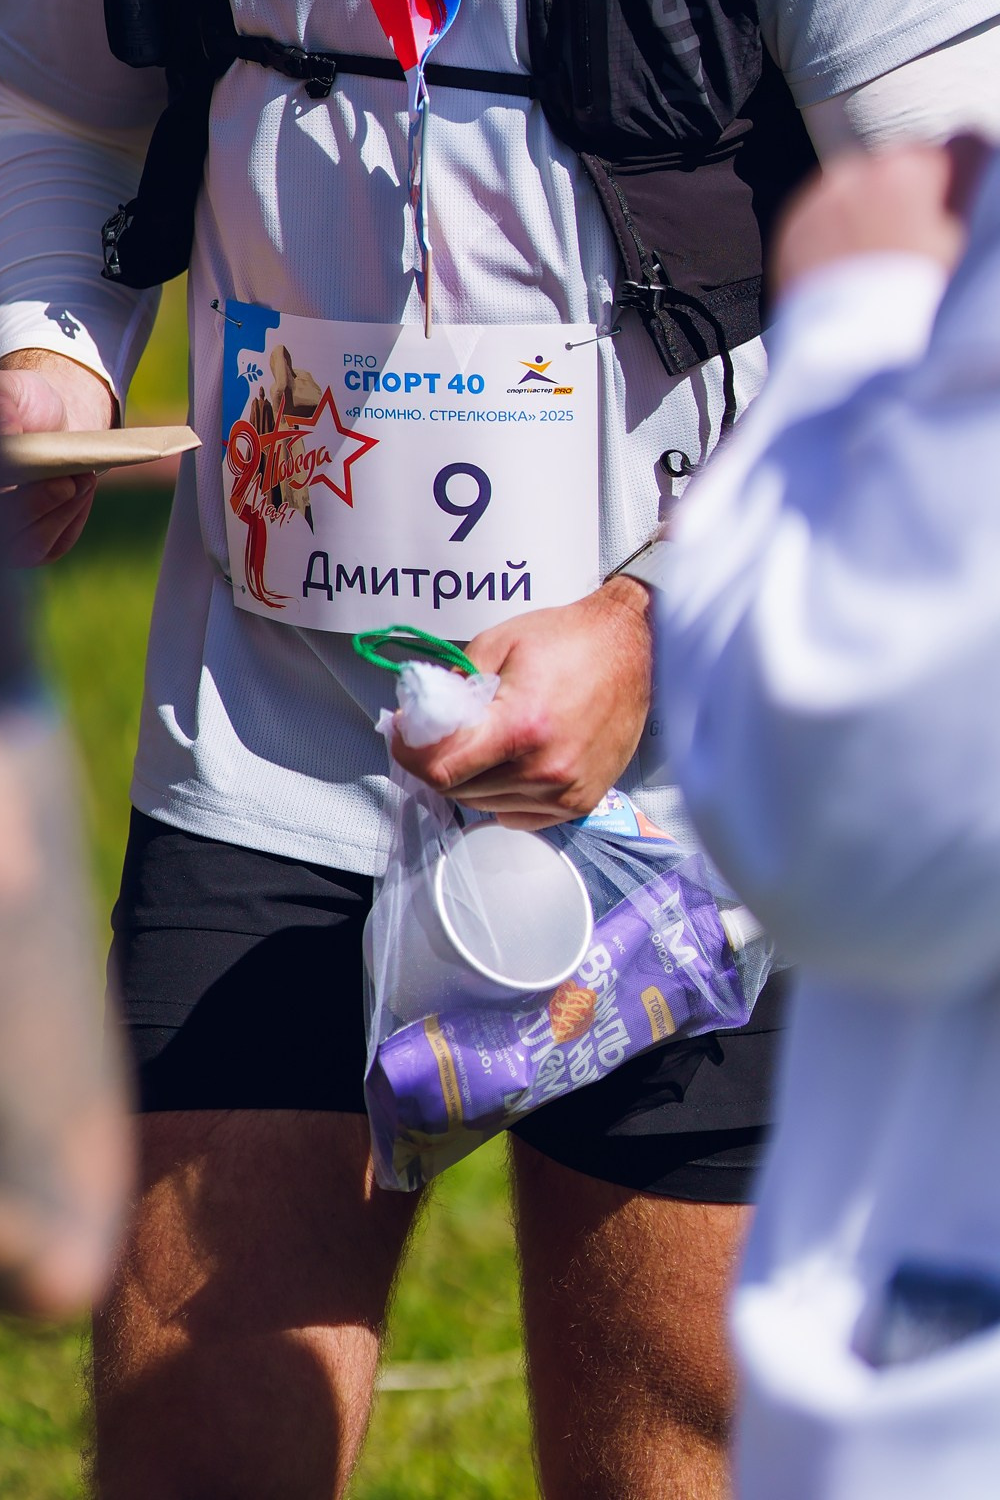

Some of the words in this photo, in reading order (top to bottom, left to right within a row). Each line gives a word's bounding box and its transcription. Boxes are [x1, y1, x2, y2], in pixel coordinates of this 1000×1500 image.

[343, 354, 377, 368] PRO
[344, 370, 441, 393] СПОРТ
[447, 373, 486, 394] 40
[345, 407, 361, 418] «Я
[364, 408, 426, 421] ПОМНЮ.
[429, 409, 537, 422] СТРЕЛКОВКА»
[539, 410, 574, 422] 2025
[433, 462, 492, 542] 9
[302, 550, 531, 610] Дмитрий
[647, 995, 669, 1039] ТОППИН
